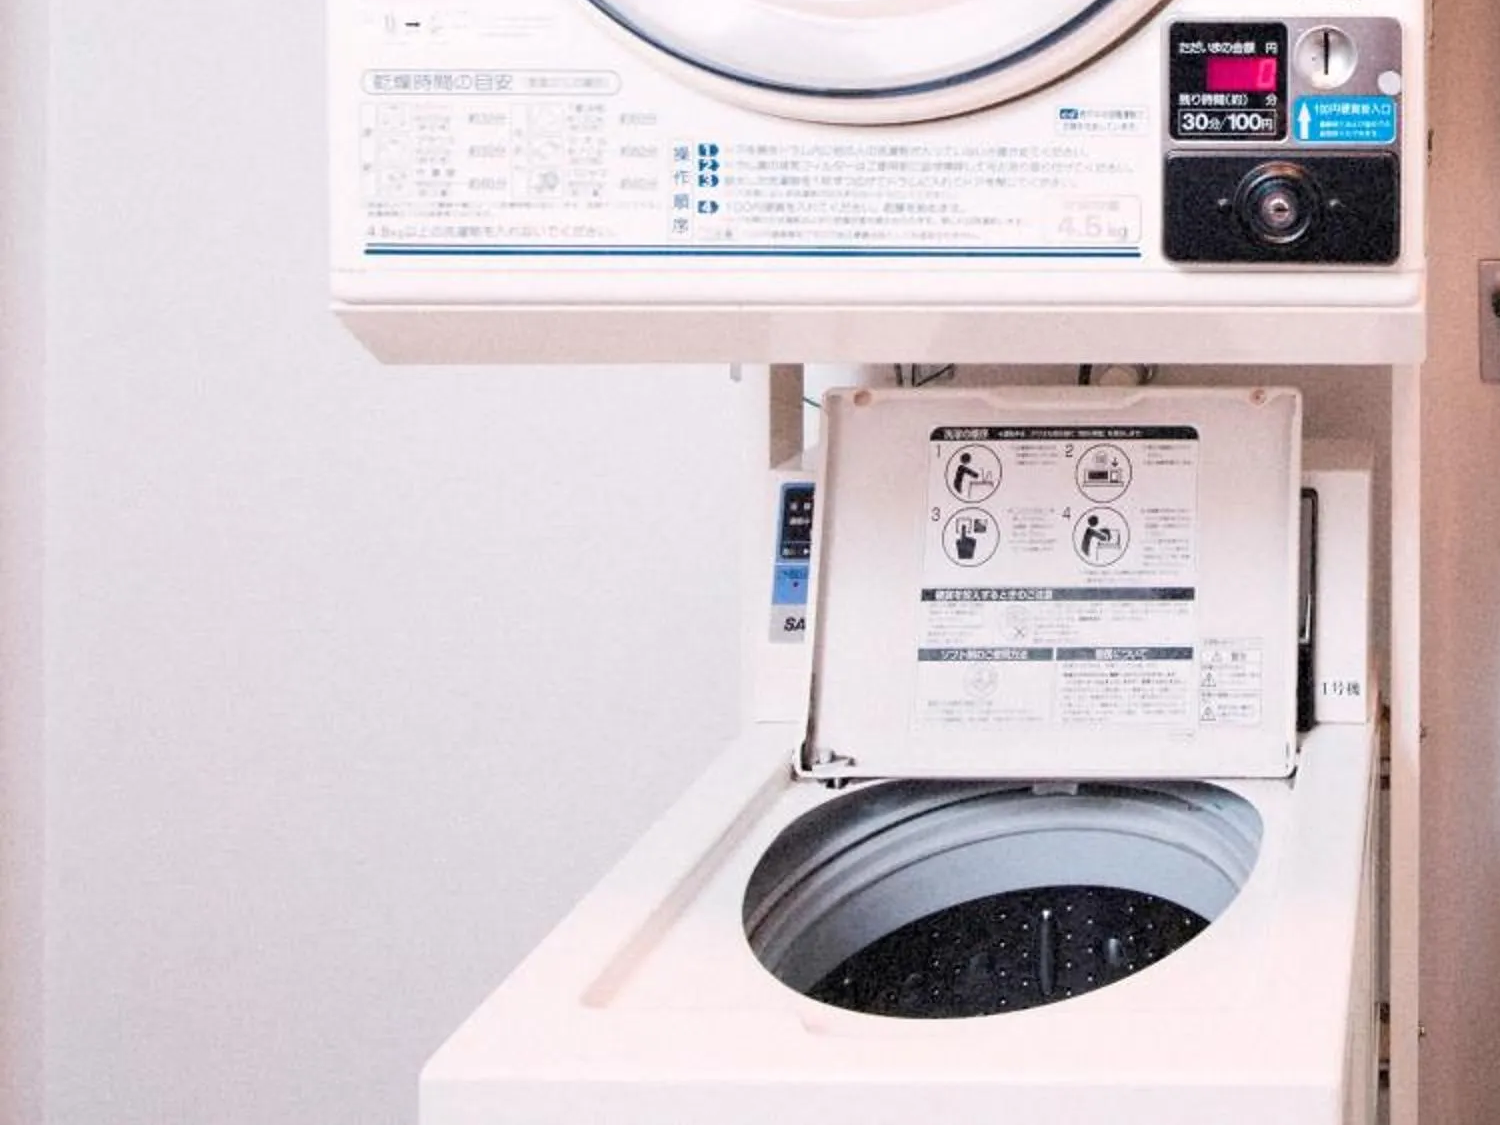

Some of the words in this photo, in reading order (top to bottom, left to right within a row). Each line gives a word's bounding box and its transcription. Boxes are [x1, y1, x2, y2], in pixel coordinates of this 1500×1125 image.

[1265, 42, 1279, 55] 円
[372, 73, 513, 92] 乾燥時間の目安
[1265, 94, 1279, 107] 分
[1181, 111, 1274, 131] 30分/100円
[1065, 444, 1074, 458] 2
[931, 508, 941, 522] 3
[1061, 507, 1071, 521] 4
